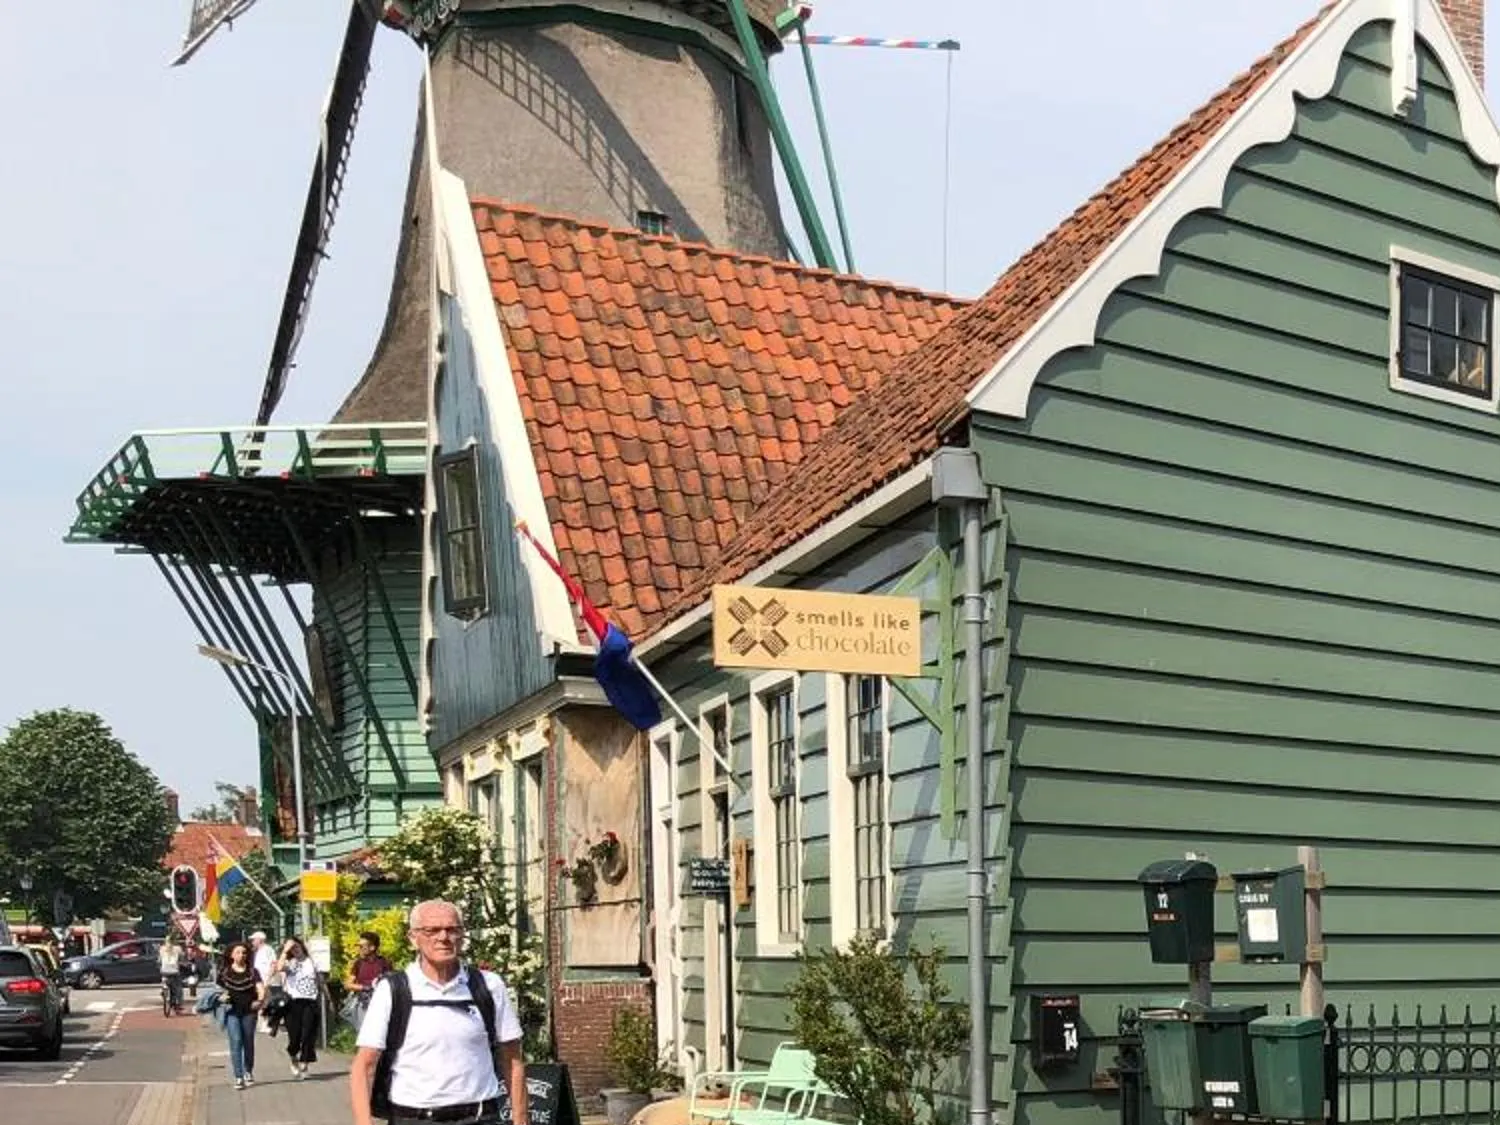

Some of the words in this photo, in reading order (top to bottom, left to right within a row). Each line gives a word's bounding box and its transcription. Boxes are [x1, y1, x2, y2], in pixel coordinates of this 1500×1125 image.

[796, 610, 864, 627] smells
[873, 611, 910, 630] like
[796, 628, 912, 655] chocolate
[1063, 1028, 1078, 1051] 14
